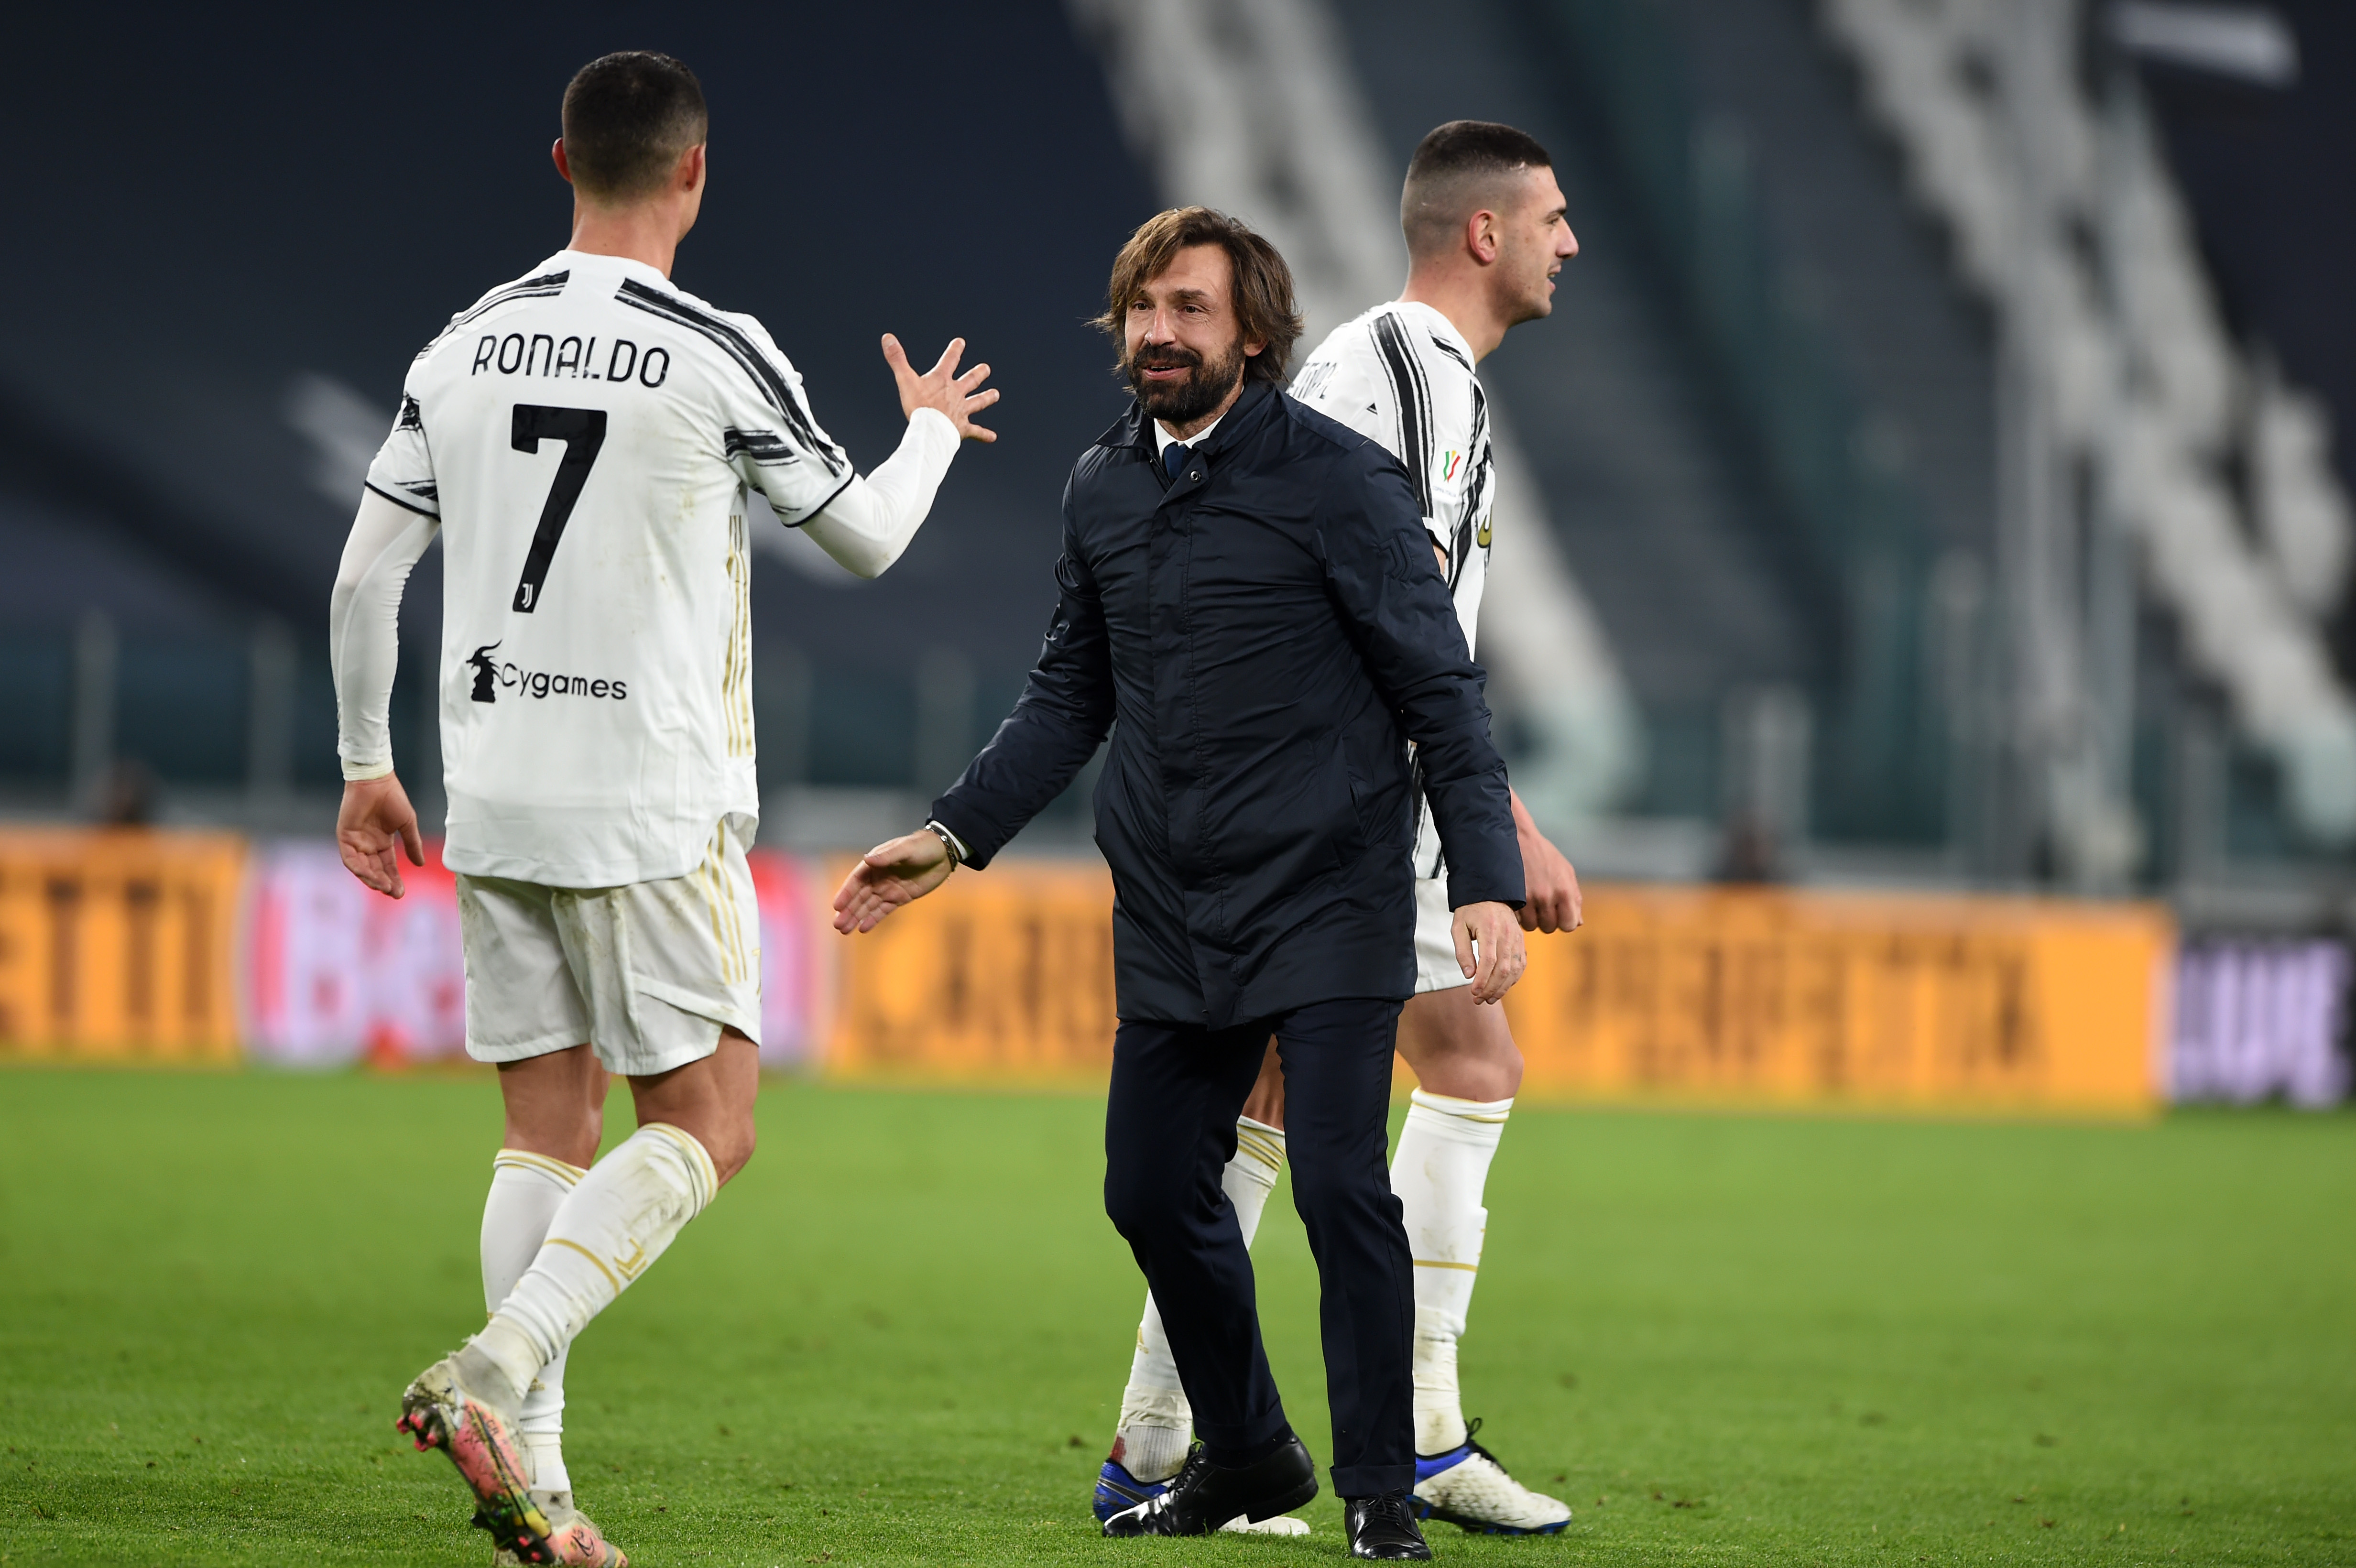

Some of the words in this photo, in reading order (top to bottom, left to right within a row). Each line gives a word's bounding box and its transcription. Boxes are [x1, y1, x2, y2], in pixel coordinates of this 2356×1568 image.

[471, 333, 670, 388] RONALDO
[511, 403, 608, 614] 7
[502, 663, 627, 700] Cygames
